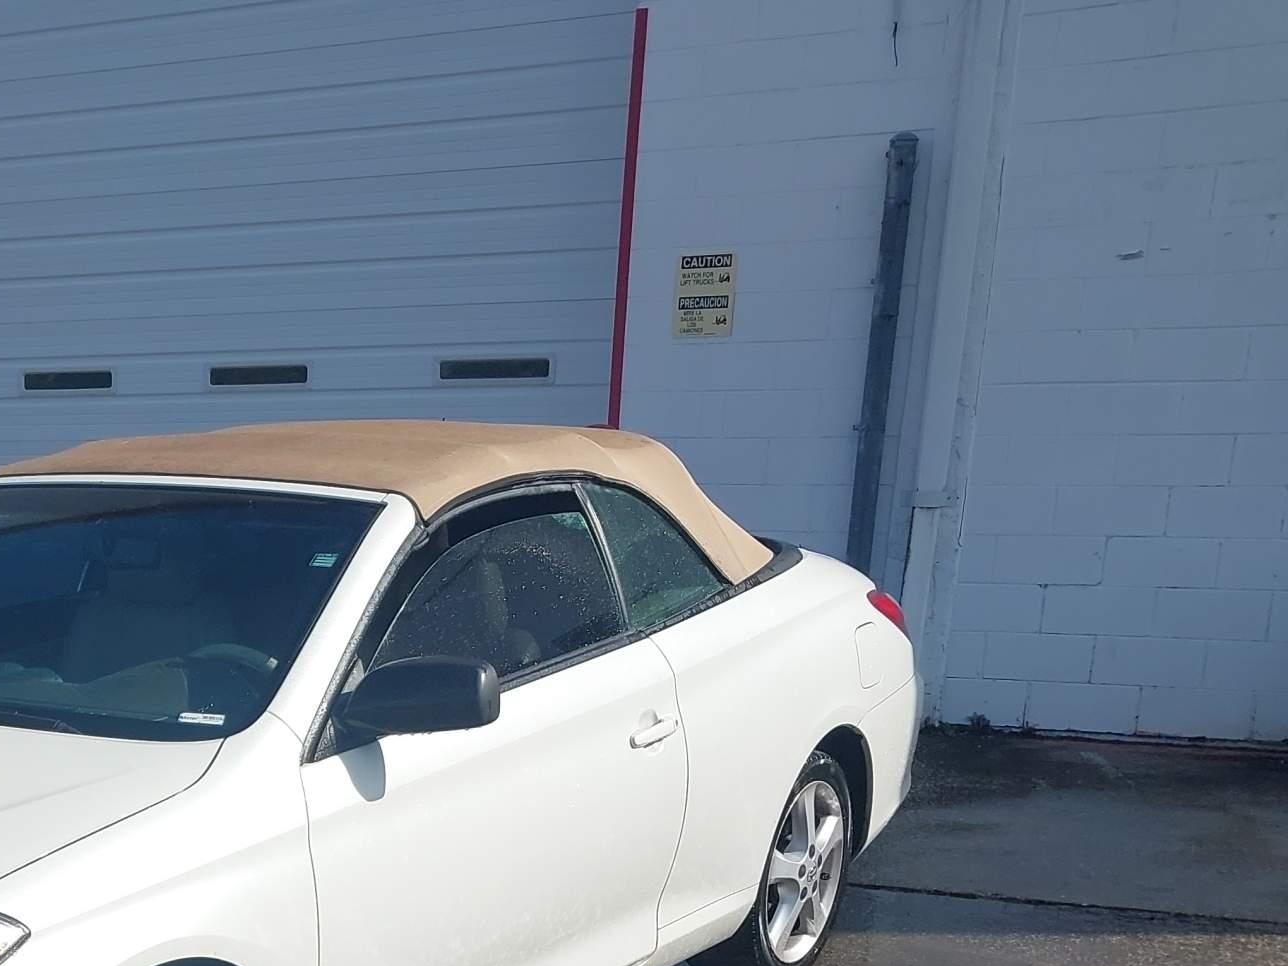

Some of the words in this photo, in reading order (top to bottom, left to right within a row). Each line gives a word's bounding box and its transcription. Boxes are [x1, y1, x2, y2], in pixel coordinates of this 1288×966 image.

[683, 255, 731, 268] CAUTION
[693, 278, 714, 286] TRUCKS
[679, 296, 728, 309] PRECAUCION
